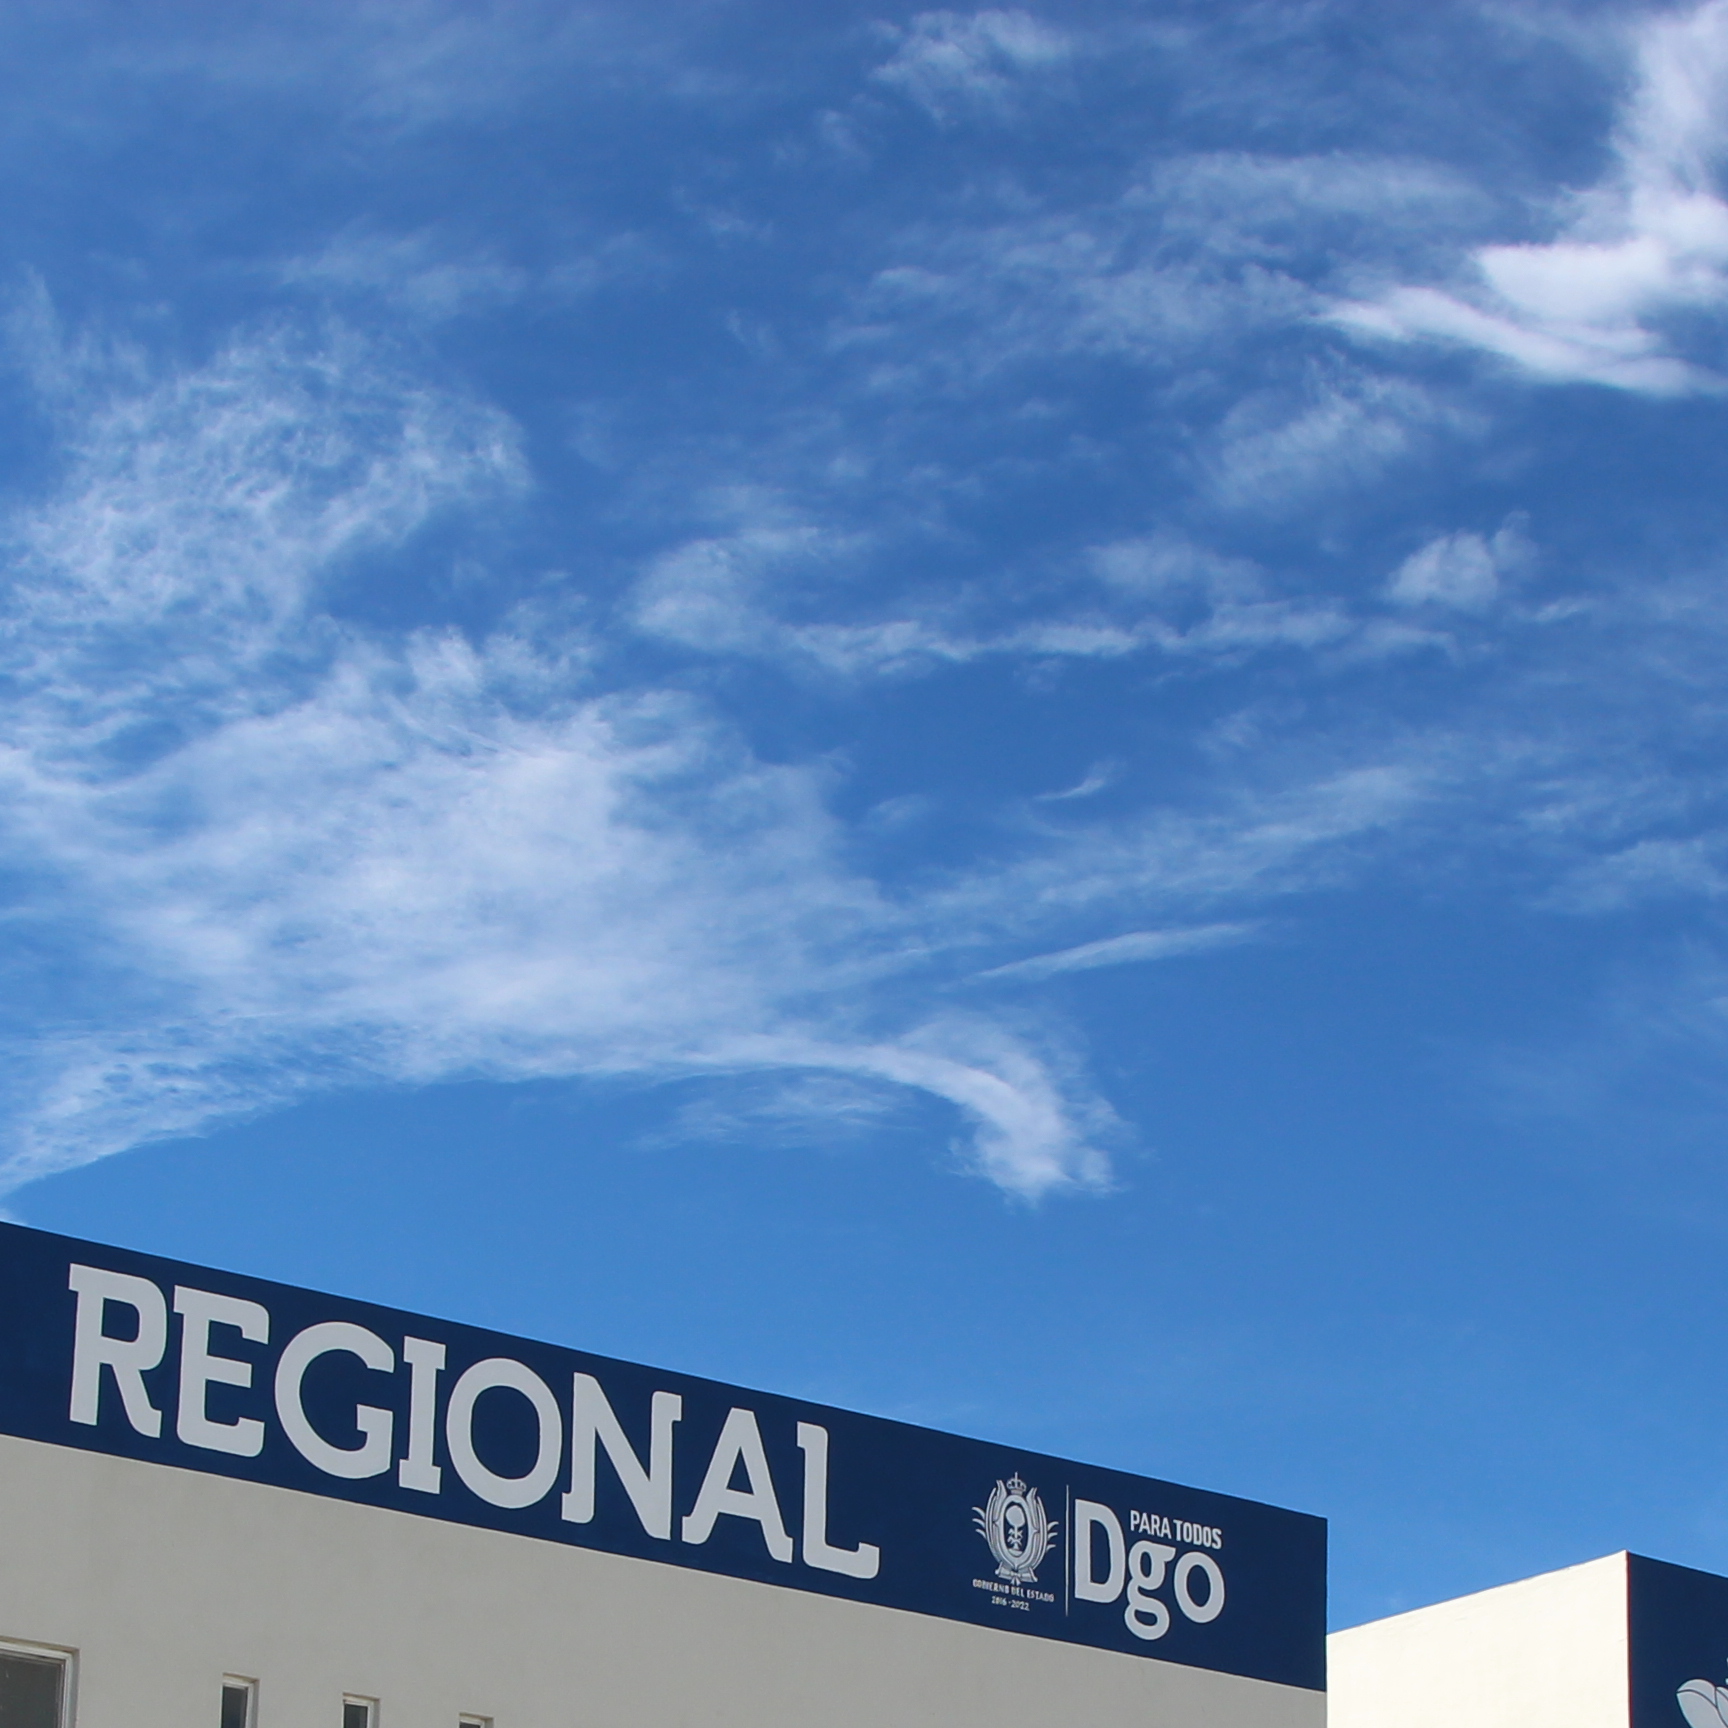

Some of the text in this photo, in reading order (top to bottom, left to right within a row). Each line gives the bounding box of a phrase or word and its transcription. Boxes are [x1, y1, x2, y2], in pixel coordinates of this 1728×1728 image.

[68, 1263, 880, 1580] REGIONAL
[1074, 1498, 1226, 1641] Dgo
[1129, 1509, 1223, 1550] PARA TODOS
[972, 1578, 1055, 1603] GOBIERNO DEL ESTADO
